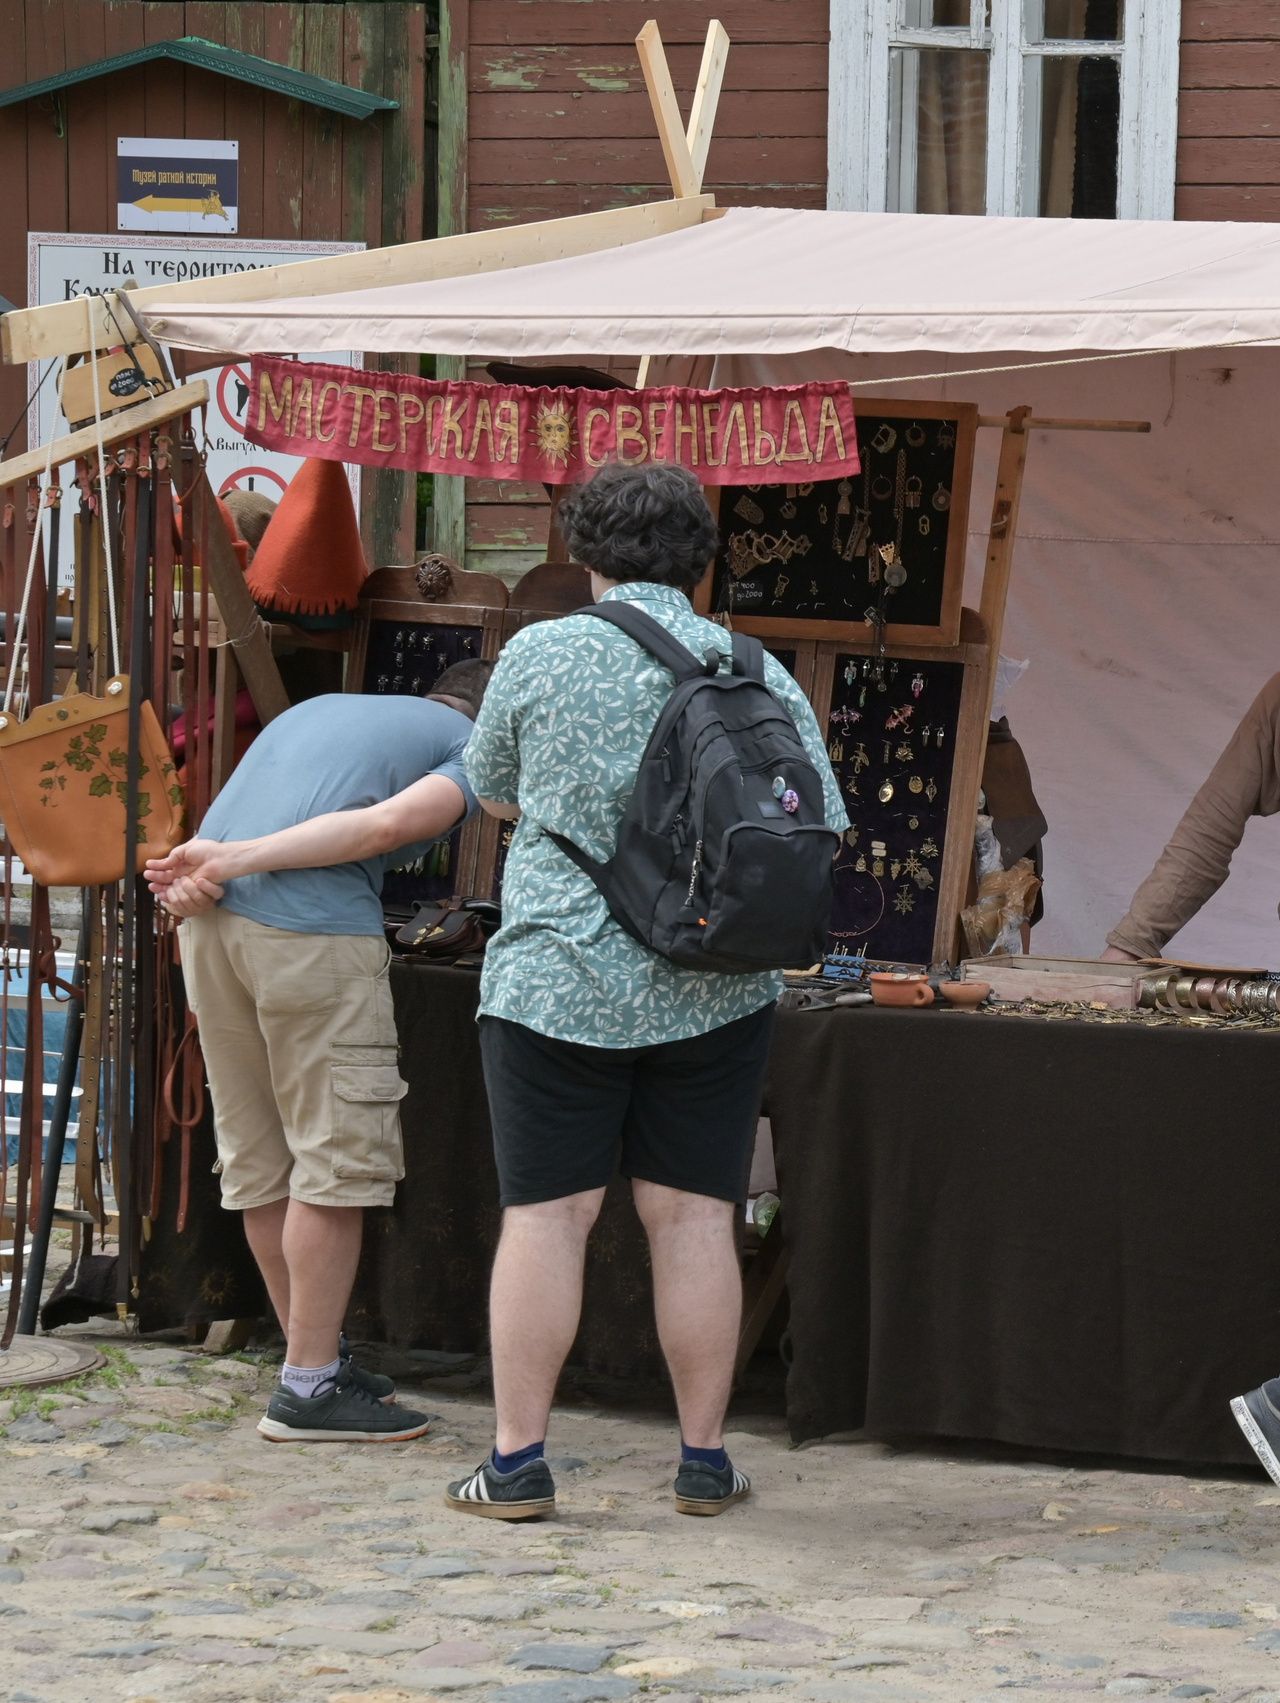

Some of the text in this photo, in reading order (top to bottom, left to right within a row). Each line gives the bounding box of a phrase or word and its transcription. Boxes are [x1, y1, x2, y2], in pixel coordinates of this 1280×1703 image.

[132, 169, 217, 187] Музей ратной истории
[103, 252, 135, 275] На
[257, 371, 846, 467] МАСТЕРСКАЯ СВЕНЕЛЬДА
[216, 437, 257, 455] Выгул
[745, 590, 763, 599] 2000
